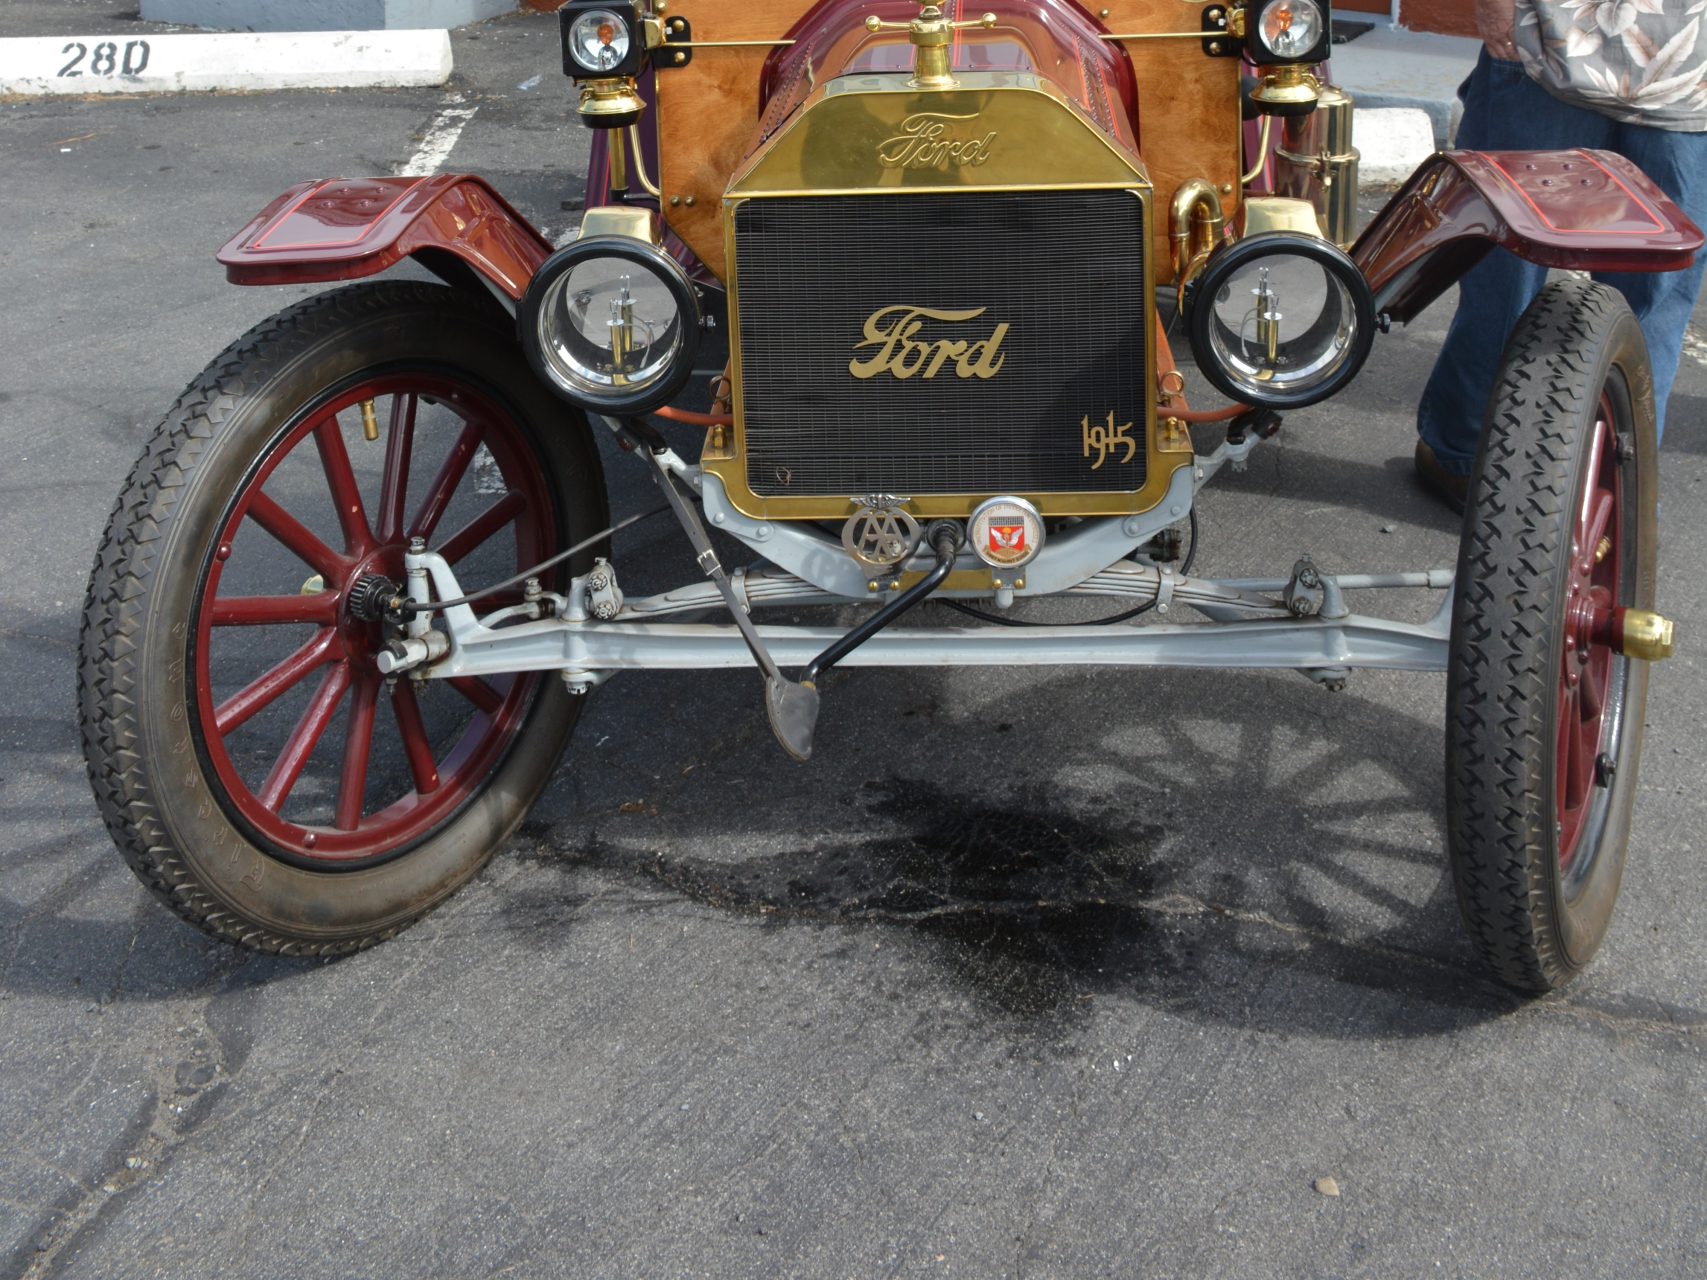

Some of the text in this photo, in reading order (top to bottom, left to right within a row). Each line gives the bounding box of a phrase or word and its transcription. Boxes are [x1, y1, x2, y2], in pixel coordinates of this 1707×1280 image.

[876, 112, 997, 169] Ford
[849, 305, 1010, 379] Ford
[1080, 409, 1136, 470] 1915
